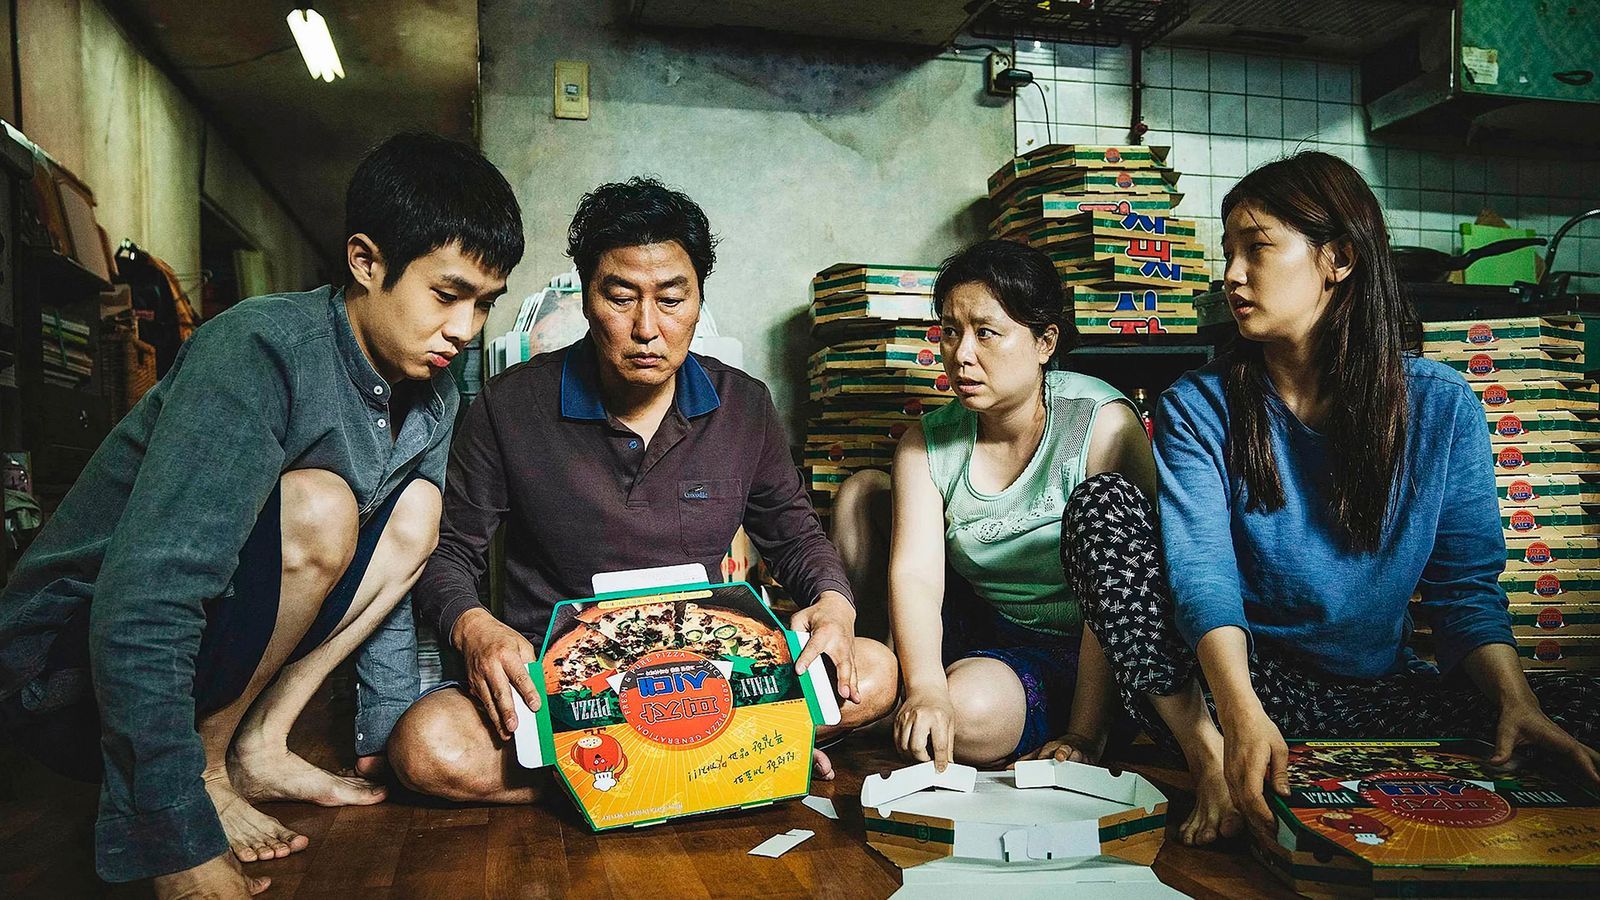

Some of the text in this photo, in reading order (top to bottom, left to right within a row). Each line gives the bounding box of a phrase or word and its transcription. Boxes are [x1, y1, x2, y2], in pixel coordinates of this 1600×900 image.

[630, 656, 652, 674] PURE
[655, 651, 686, 659] PIZZA
[698, 658, 724, 680] SINCE
[636, 669, 709, 698] 시대
[721, 682, 730, 703] 2010
[740, 675, 780, 698] ITALY
[570, 697, 612, 721] PIZZA
[620, 686, 632, 715] FRESH
[640, 696, 720, 724] 피자
[635, 724, 702, 745] GENERATION
[705, 712, 728, 735] PIZZA
